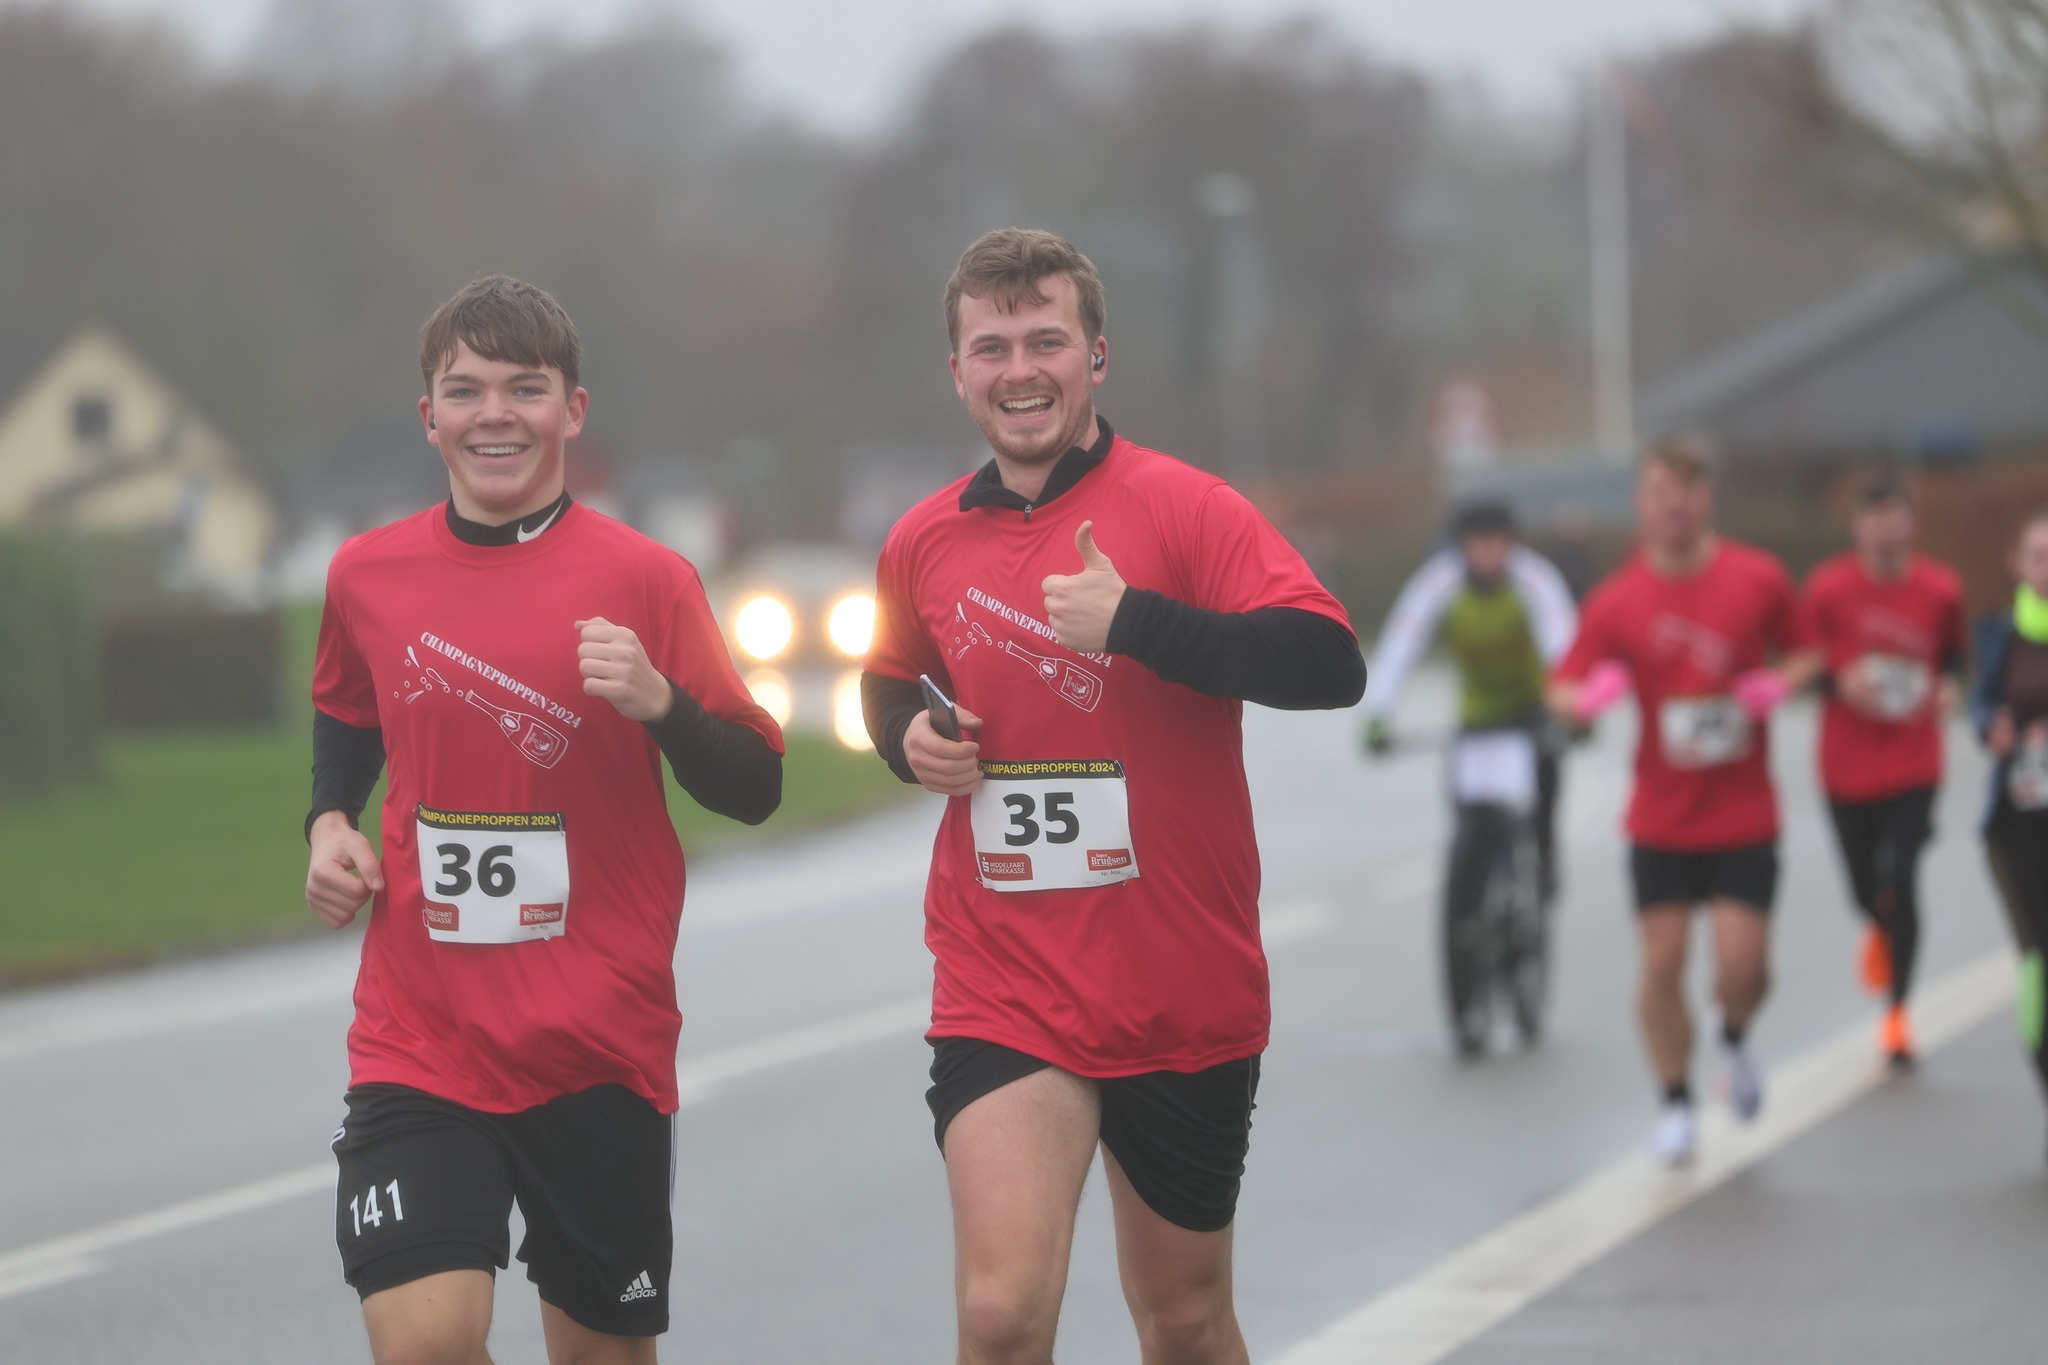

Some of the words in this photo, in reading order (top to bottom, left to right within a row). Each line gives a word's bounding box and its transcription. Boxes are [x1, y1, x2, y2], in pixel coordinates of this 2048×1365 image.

[966, 586, 1067, 648] CHAMPAGNEPROP
[1077, 651, 1112, 668] 024
[420, 631, 549, 710] CHAMPAGNEPROPPEN
[546, 701, 582, 730] 2024
[1089, 762, 1115, 773] 2024
[531, 815, 557, 826] 2024
[1002, 791, 1080, 847] 35
[435, 842, 516, 898] 36
[1091, 856, 1127, 866] Brugsen
[349, 1178, 404, 1237] 141
[619, 1286, 658, 1303] adidas
